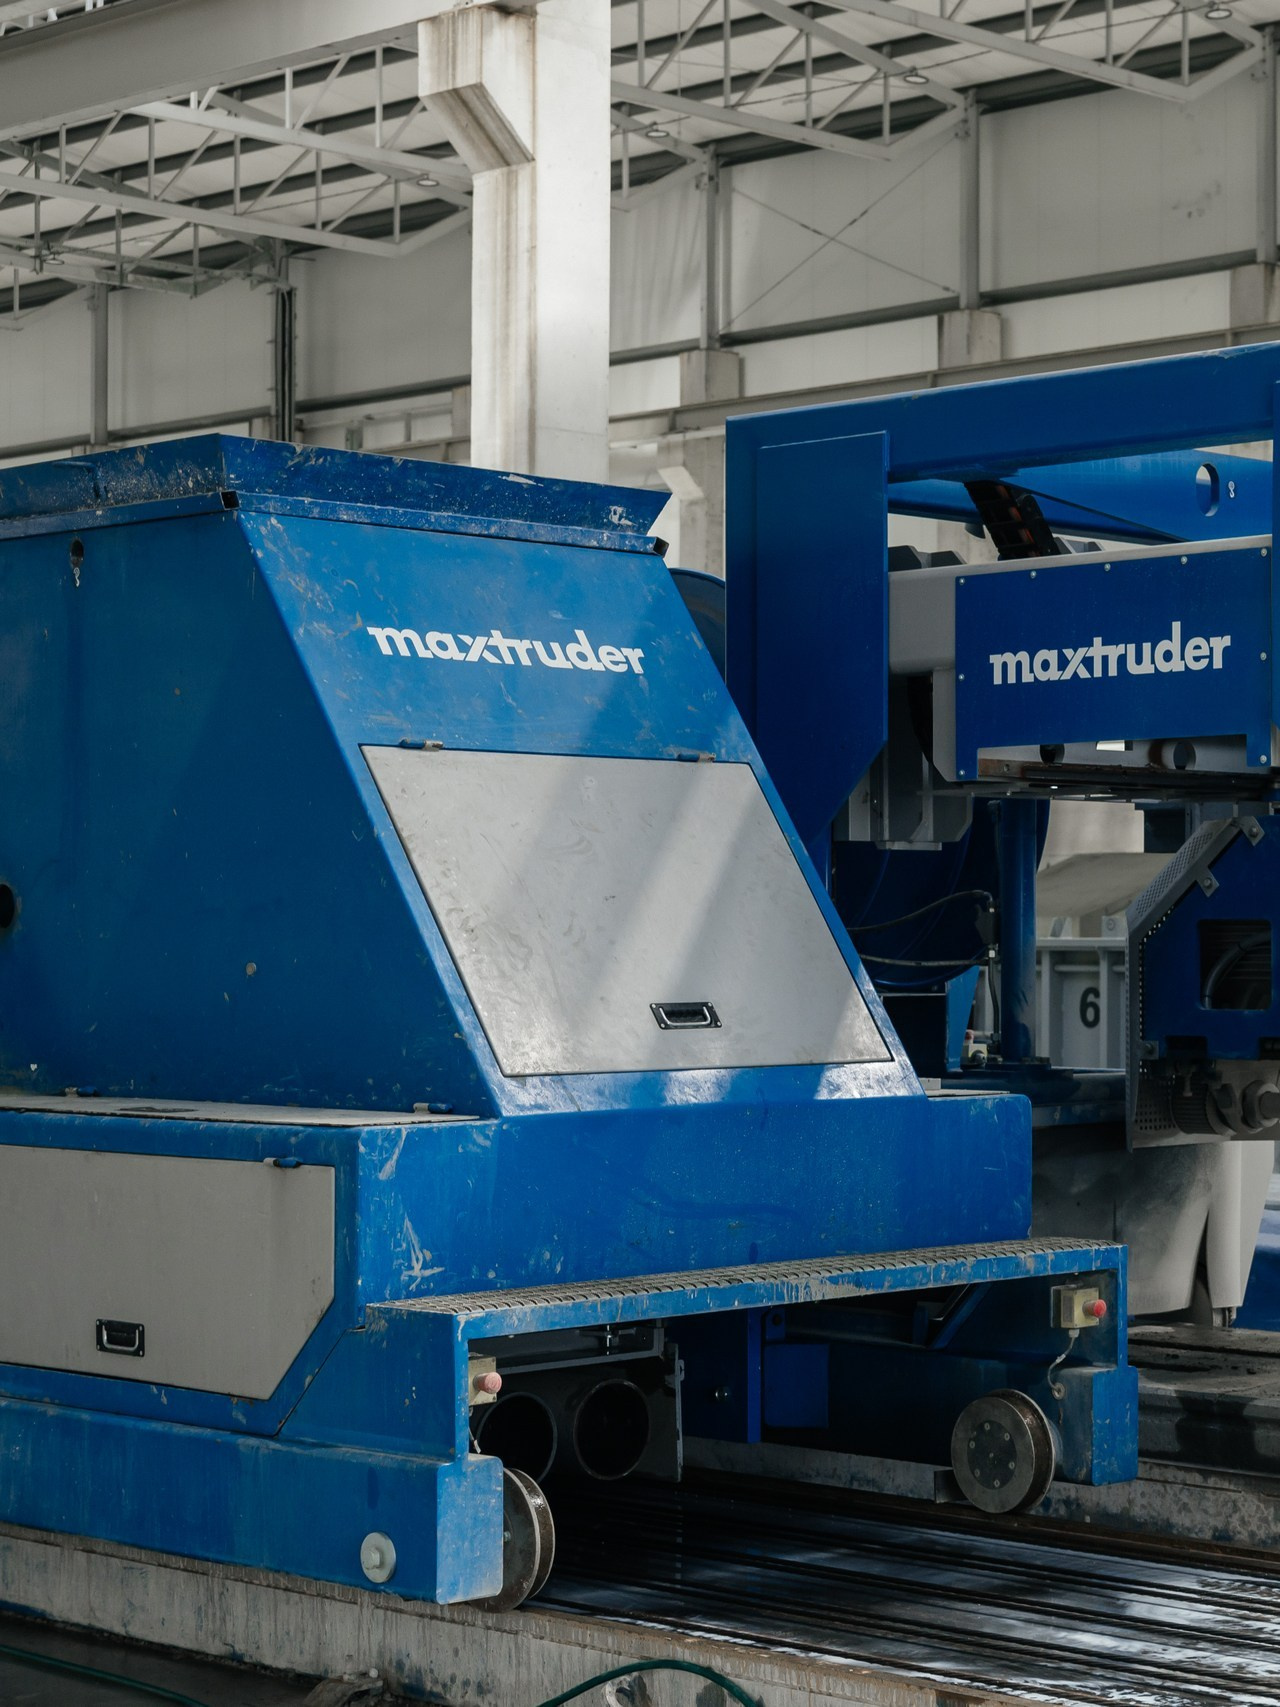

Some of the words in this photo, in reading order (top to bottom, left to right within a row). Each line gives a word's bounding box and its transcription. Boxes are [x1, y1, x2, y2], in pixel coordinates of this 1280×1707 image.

[367, 627, 644, 674] maxtruder
[990, 621, 1231, 684] maxtruder
[1079, 987, 1101, 1028] 6
